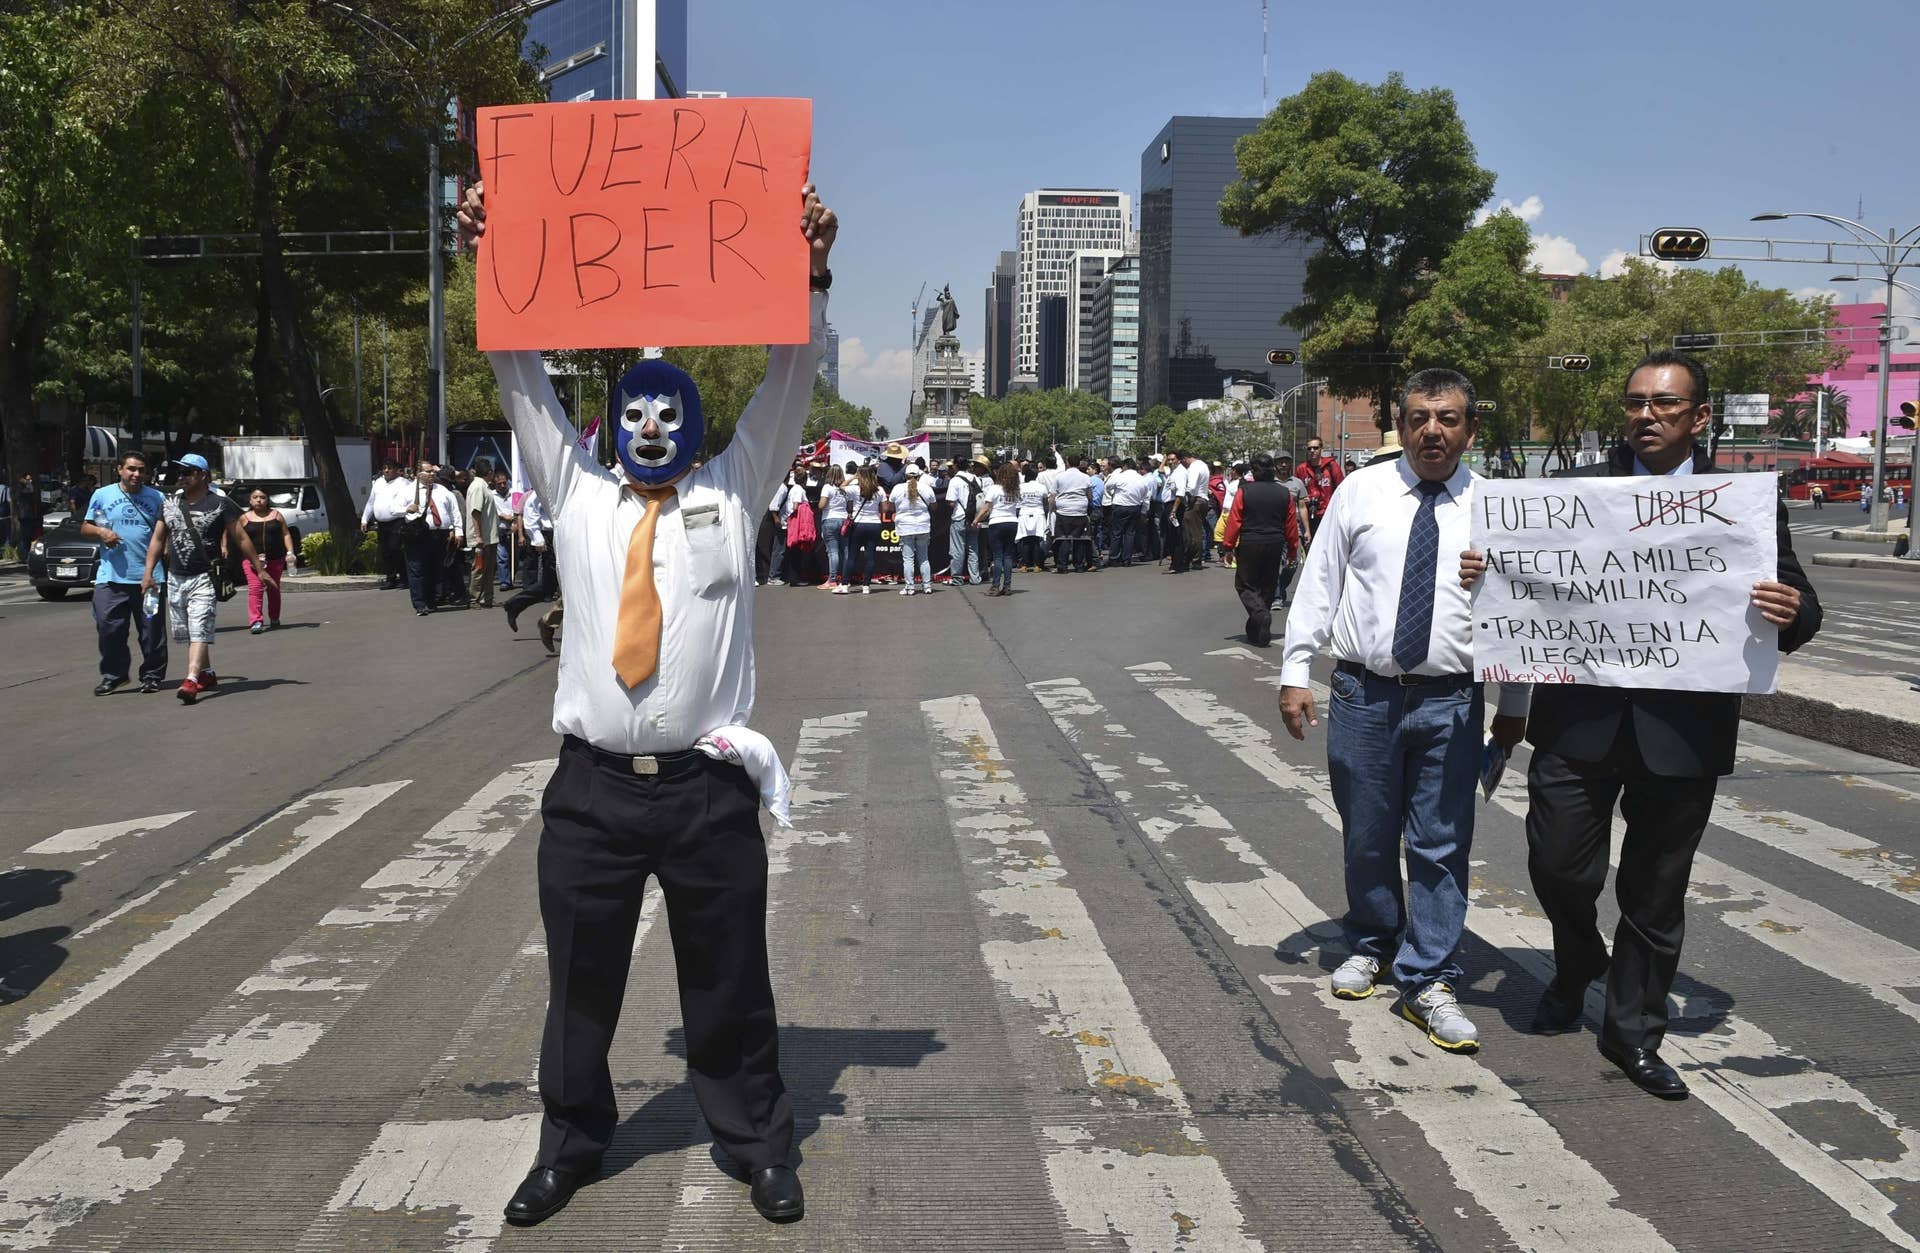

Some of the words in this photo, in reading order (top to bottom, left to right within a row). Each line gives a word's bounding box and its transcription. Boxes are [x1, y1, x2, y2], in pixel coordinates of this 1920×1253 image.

[485, 108, 768, 196] FUERA
[1062, 196, 1101, 204] MAPFRE
[491, 199, 766, 314] UBER
[1482, 494, 1595, 531] FUERA
[1634, 489, 1733, 526] UBER
[1485, 547, 1587, 578] AFECTA
[1602, 549, 1625, 573] A
[1632, 546, 1728, 573] MILES
[1511, 580, 1544, 600] DE
[1553, 578, 1687, 604] FAMILIAS
[1627, 621, 1671, 644] EN
[1679, 618, 1720, 644] LA
[1520, 645, 1679, 668] ILEGALIDAD
